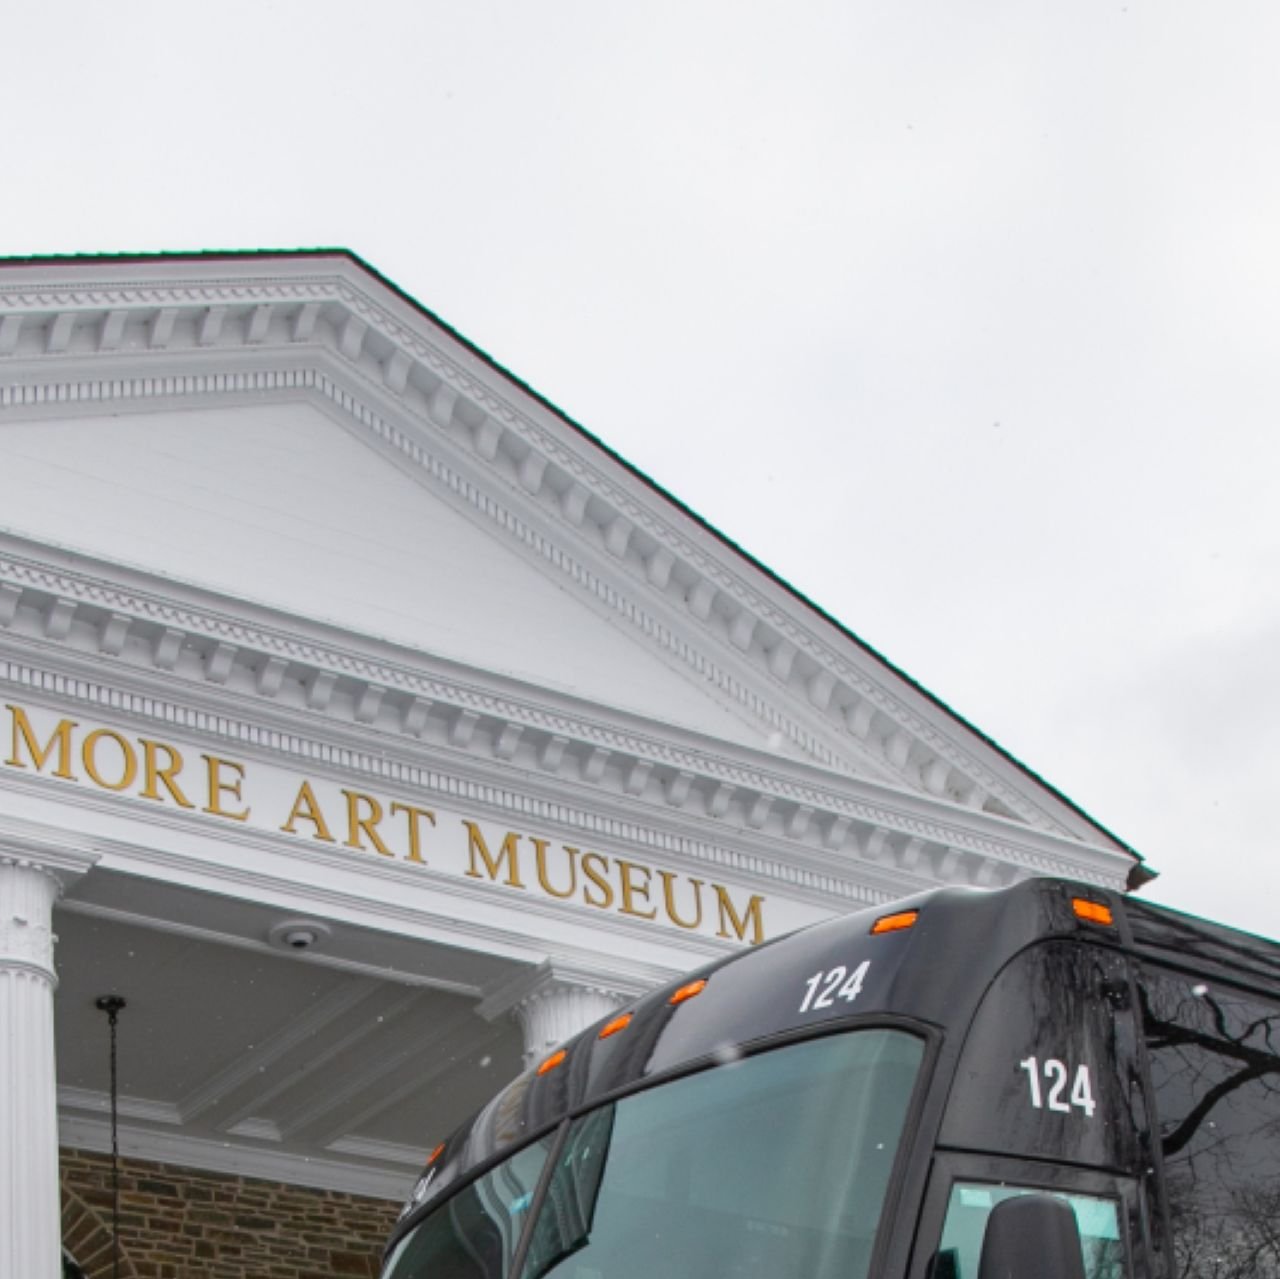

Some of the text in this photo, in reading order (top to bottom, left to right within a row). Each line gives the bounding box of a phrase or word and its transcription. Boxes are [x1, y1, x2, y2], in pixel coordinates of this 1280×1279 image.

[280, 779, 436, 865] ART
[460, 819, 766, 946] MUSEUM
[799, 960, 870, 1013] 124
[1021, 1056, 1097, 1117] 124
